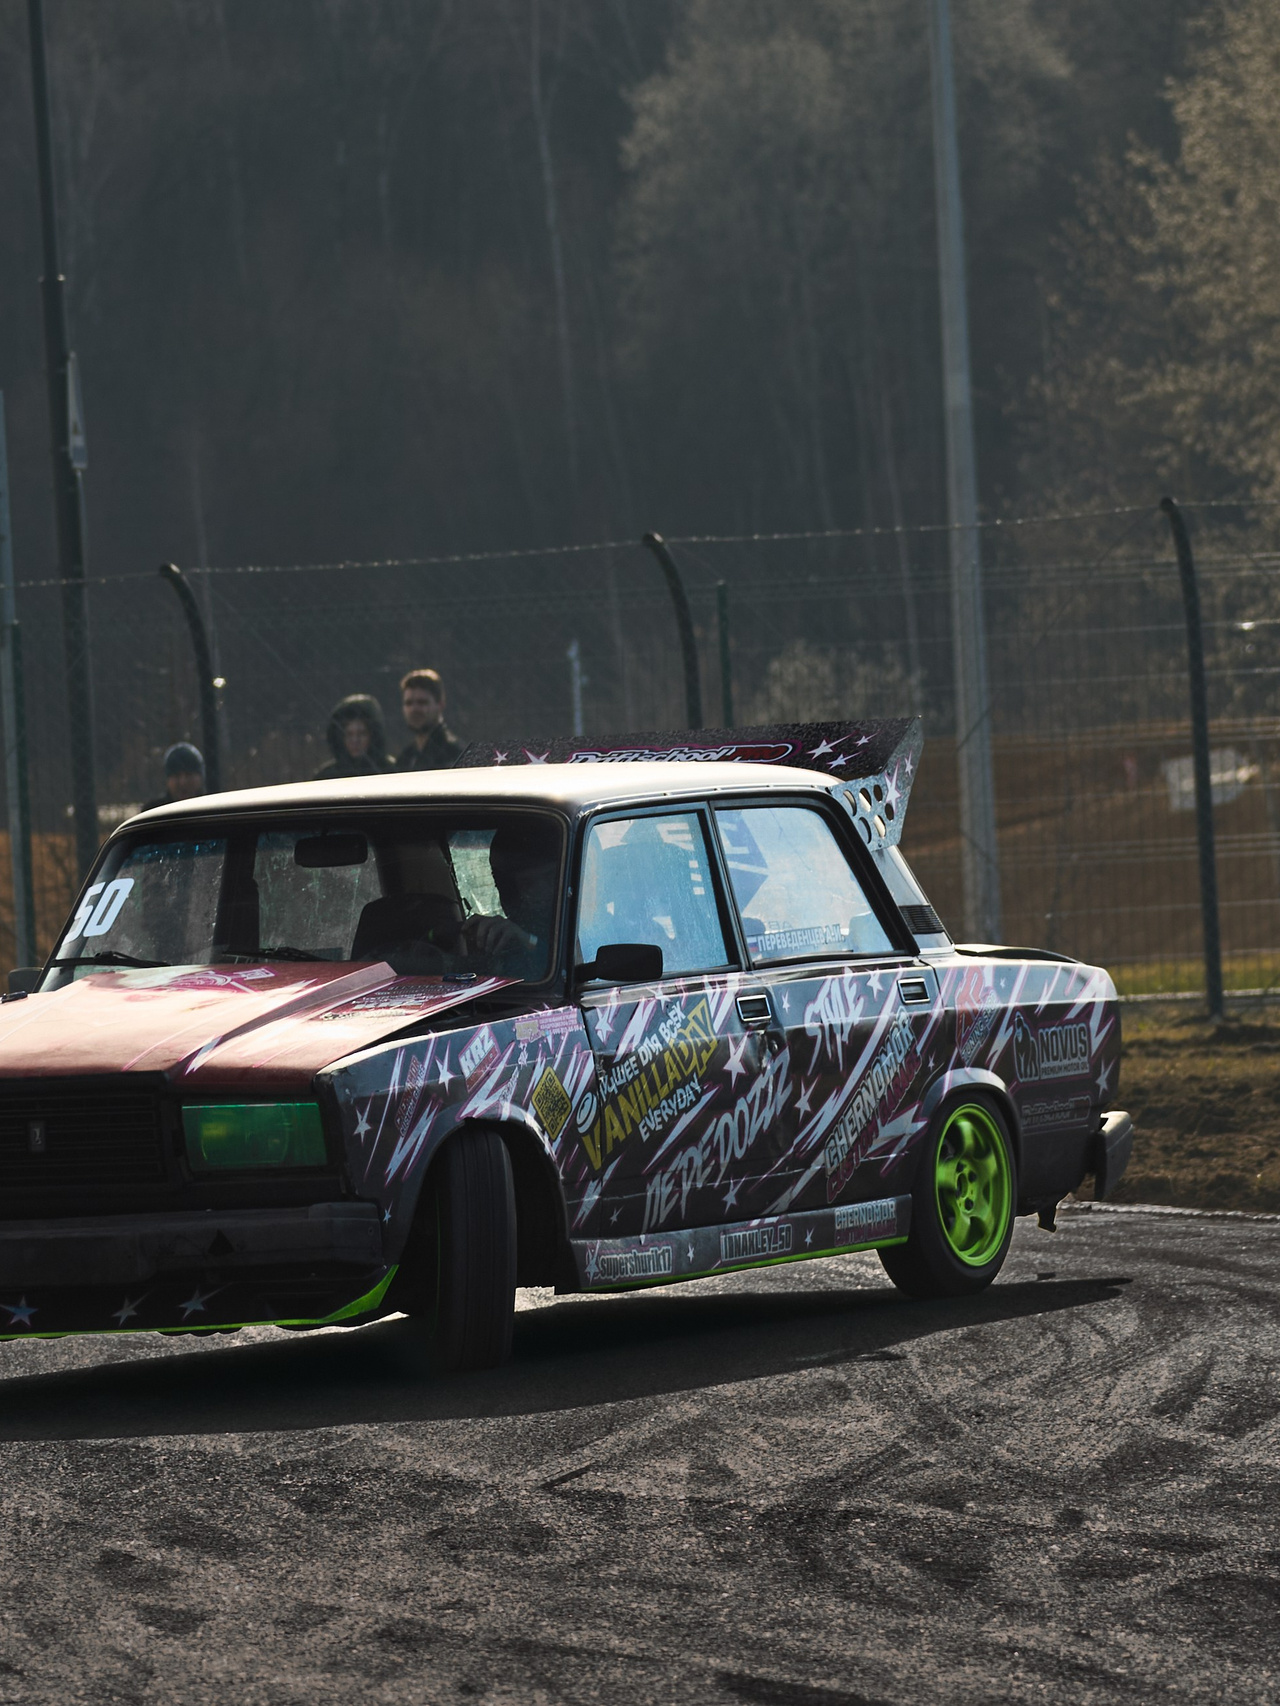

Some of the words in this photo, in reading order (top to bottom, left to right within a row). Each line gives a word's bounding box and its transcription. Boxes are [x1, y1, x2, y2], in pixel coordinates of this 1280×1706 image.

[61, 878, 135, 945] 50
[460, 1025, 495, 1079] KRZ
[1039, 1023, 1088, 1064] NOVUS
[638, 1072, 702, 1143] EVERYDAY
[824, 1008, 916, 1177] CHERNOMOR
[834, 1199, 897, 1230] CHERNOMOR
